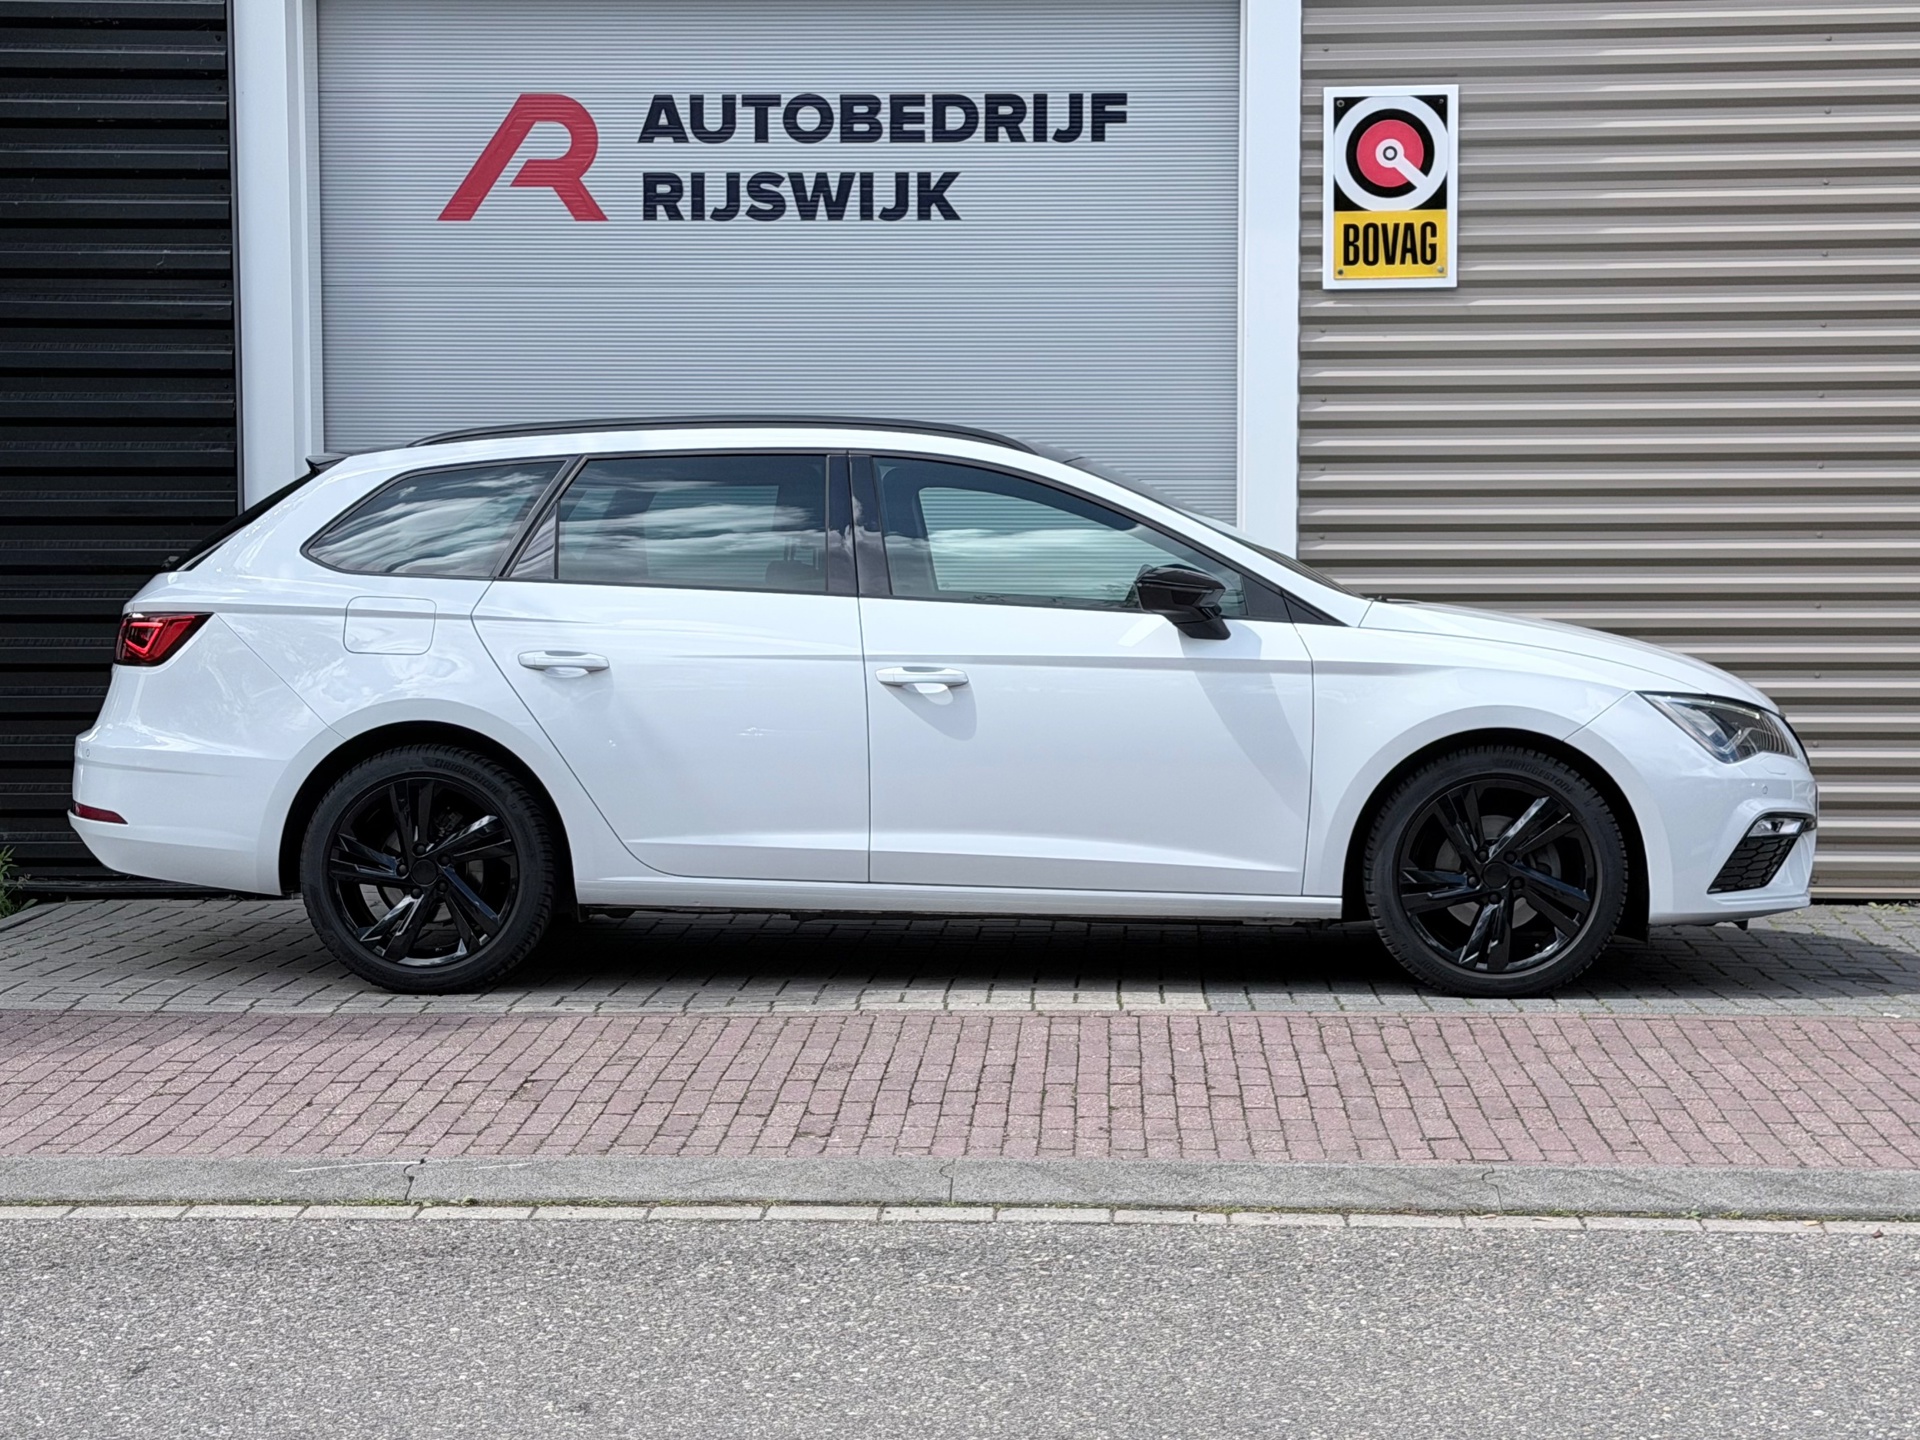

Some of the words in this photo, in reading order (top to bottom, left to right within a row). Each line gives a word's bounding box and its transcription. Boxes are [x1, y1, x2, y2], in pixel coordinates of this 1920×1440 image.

[638, 93, 1128, 144] AUTOBEDRIJF
[642, 171, 962, 222] RIJSWIJK
[1343, 221, 1438, 266] BOVAG
